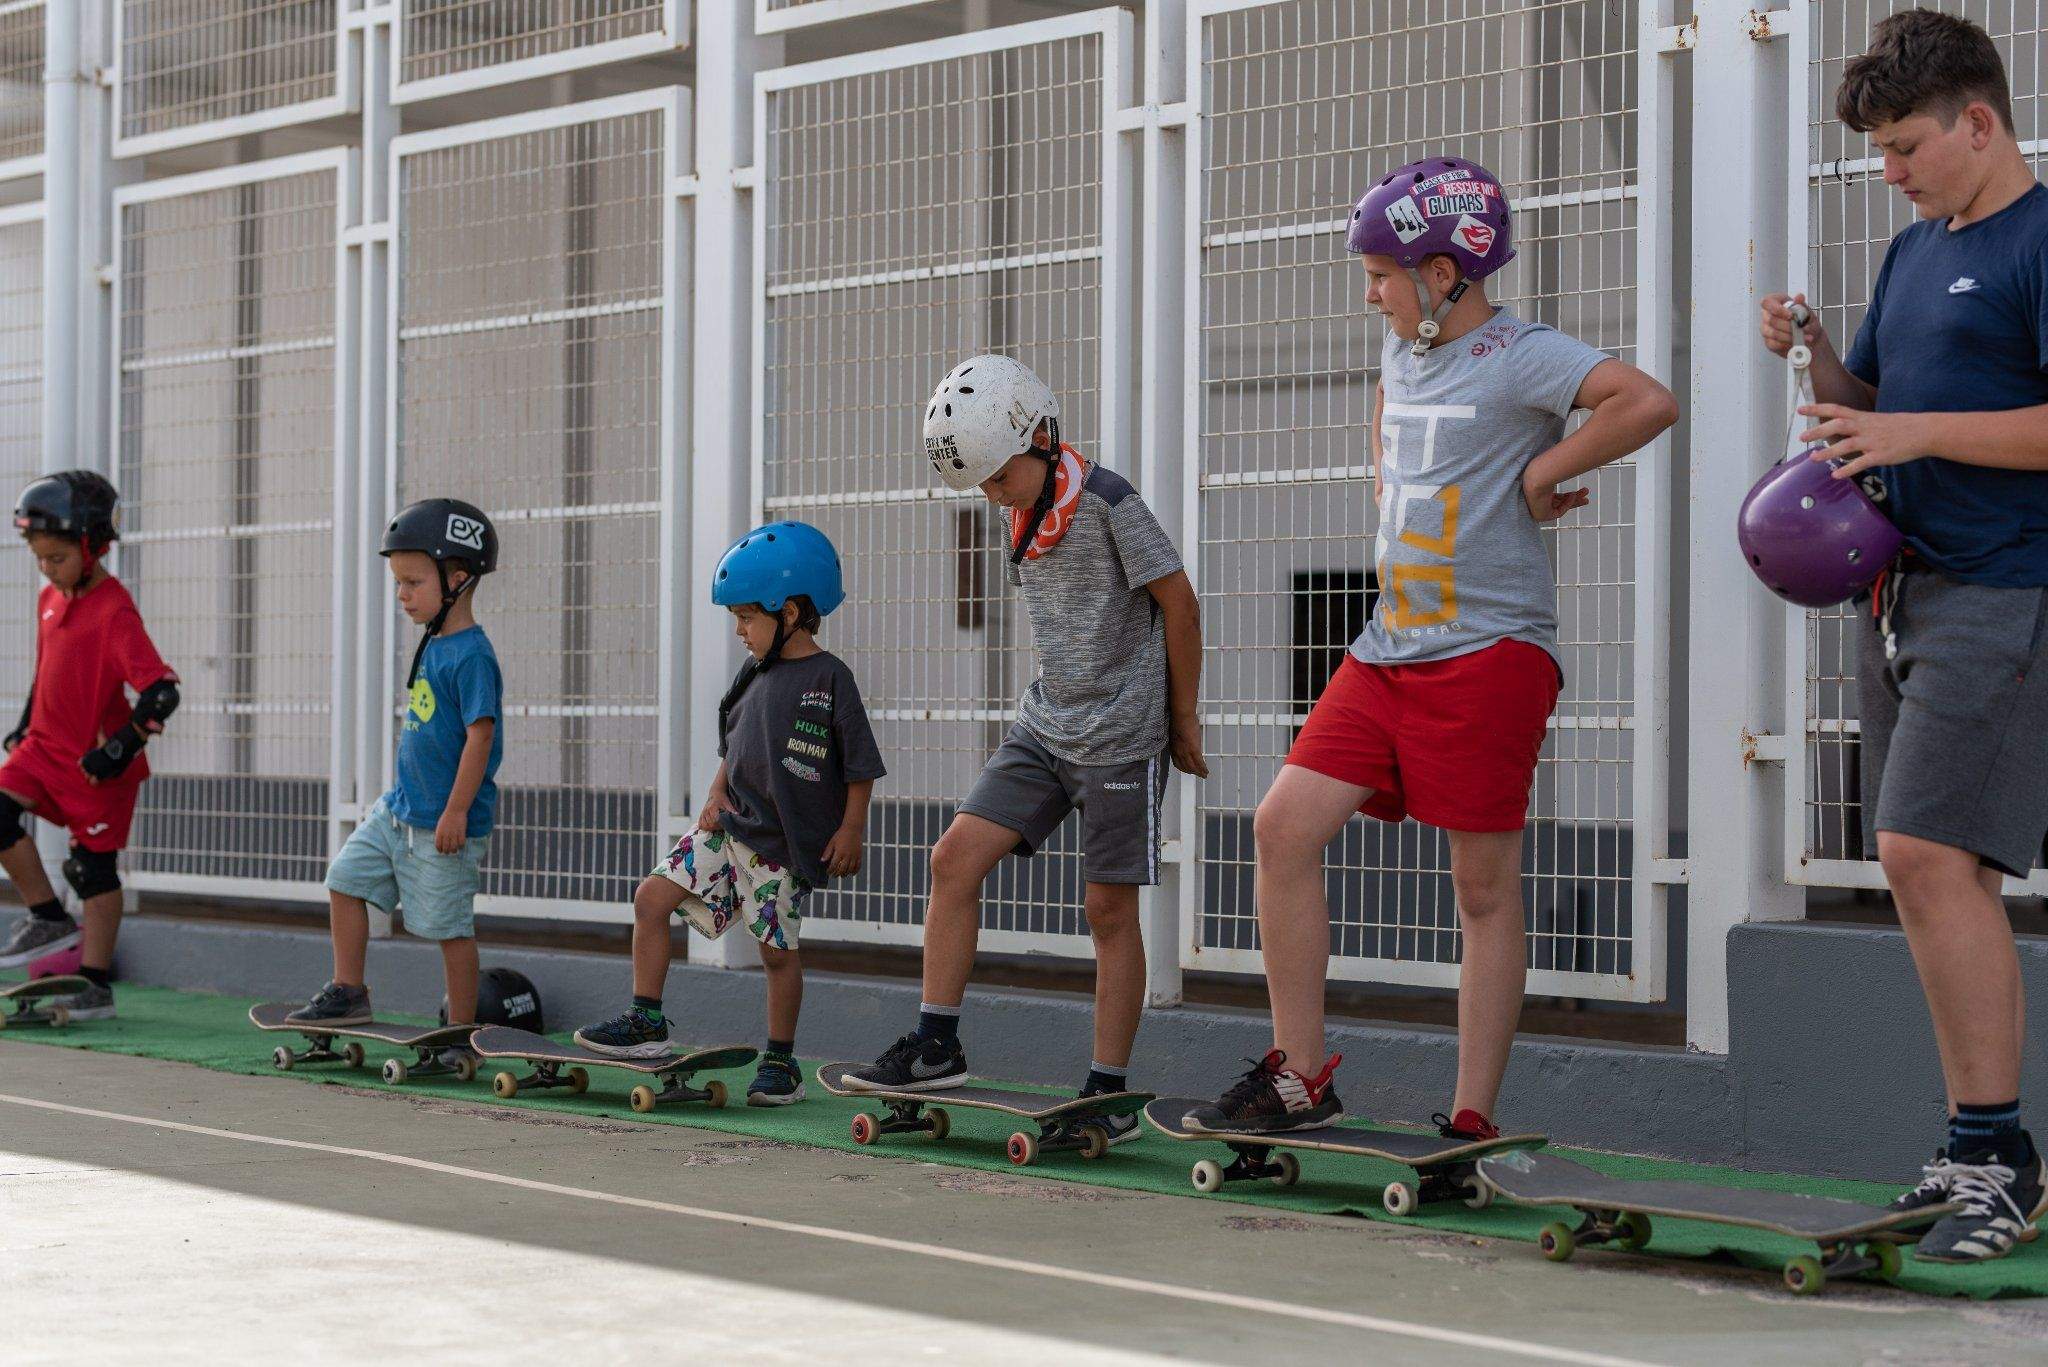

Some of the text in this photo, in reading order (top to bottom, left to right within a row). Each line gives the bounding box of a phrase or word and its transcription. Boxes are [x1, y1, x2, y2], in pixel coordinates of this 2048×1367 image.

[1415, 184, 1424, 192] IN
[1423, 176, 1441, 188] CASE
[1442, 173, 1451, 181] OF
[1443, 181, 1495, 197] RESCUE MY
[1428, 193, 1484, 216] GUITARS
[802, 691, 833, 702] CAPTAI
[800, 700, 833, 711] AMERIC
[794, 720, 828, 739] HULK
[787, 738, 828, 760] IRON MAN
[1103, 781, 1131, 790] adidas
